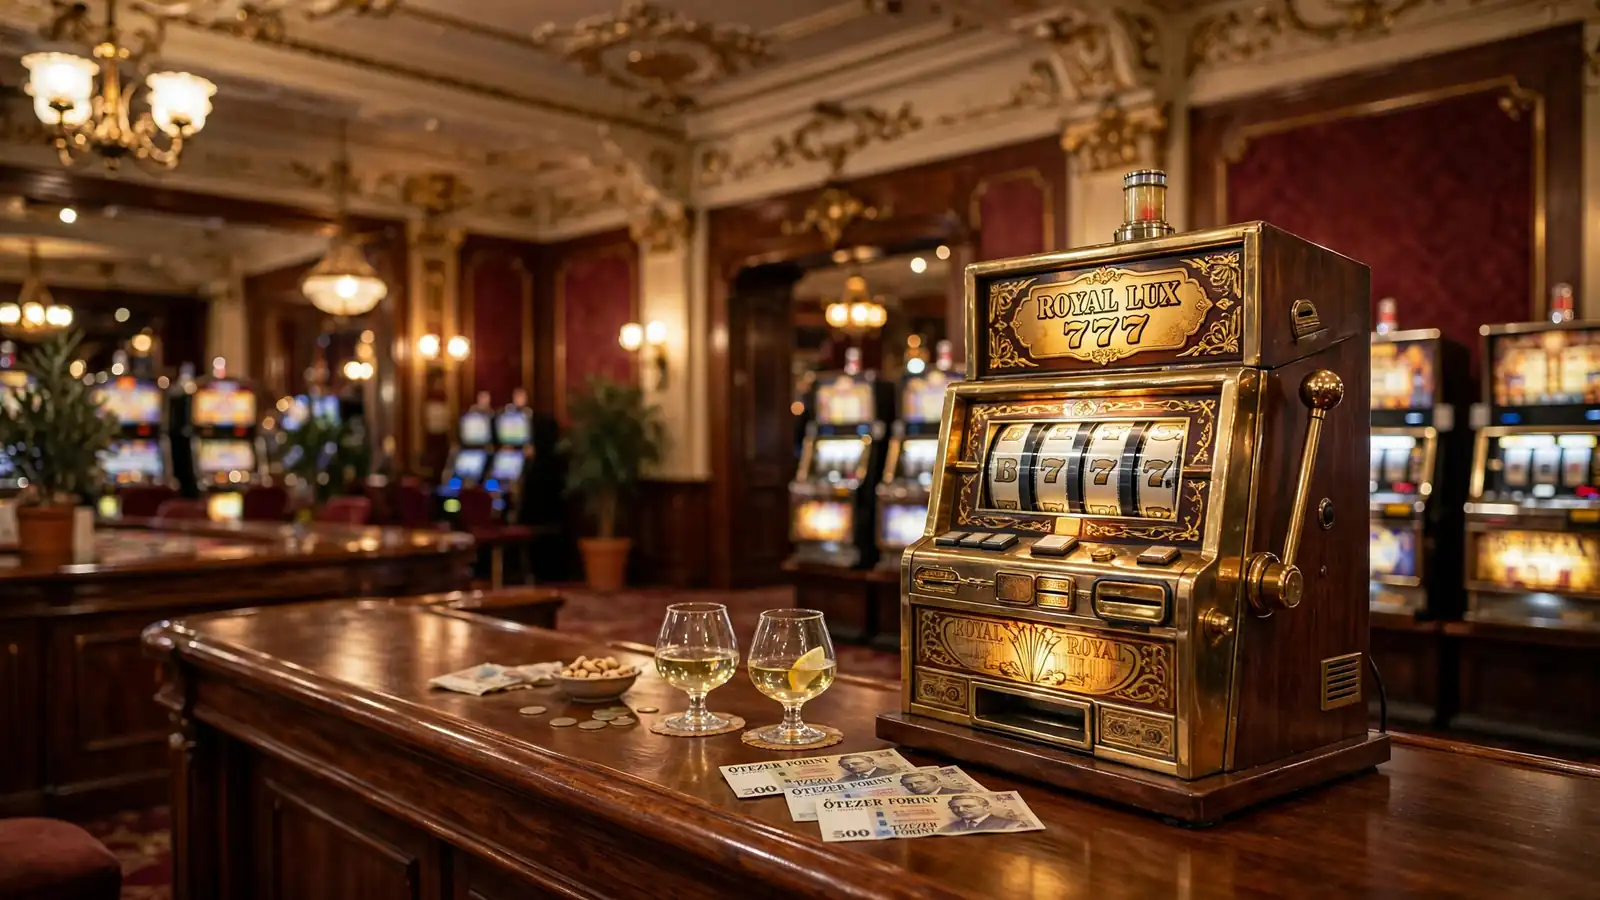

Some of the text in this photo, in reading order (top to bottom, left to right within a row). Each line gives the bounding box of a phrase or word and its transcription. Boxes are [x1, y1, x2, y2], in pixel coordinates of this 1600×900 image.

[1037, 280, 1181, 319] ROYAL LUX
[1064, 314, 1150, 349] 777
[994, 457, 1174, 488] B 7 7 7
[952, 619, 1126, 662] ROYAL ROYAL
[850, 776, 894, 788] FORINT
[888, 796, 939, 806] FORINT
[832, 829, 870, 838] 500
